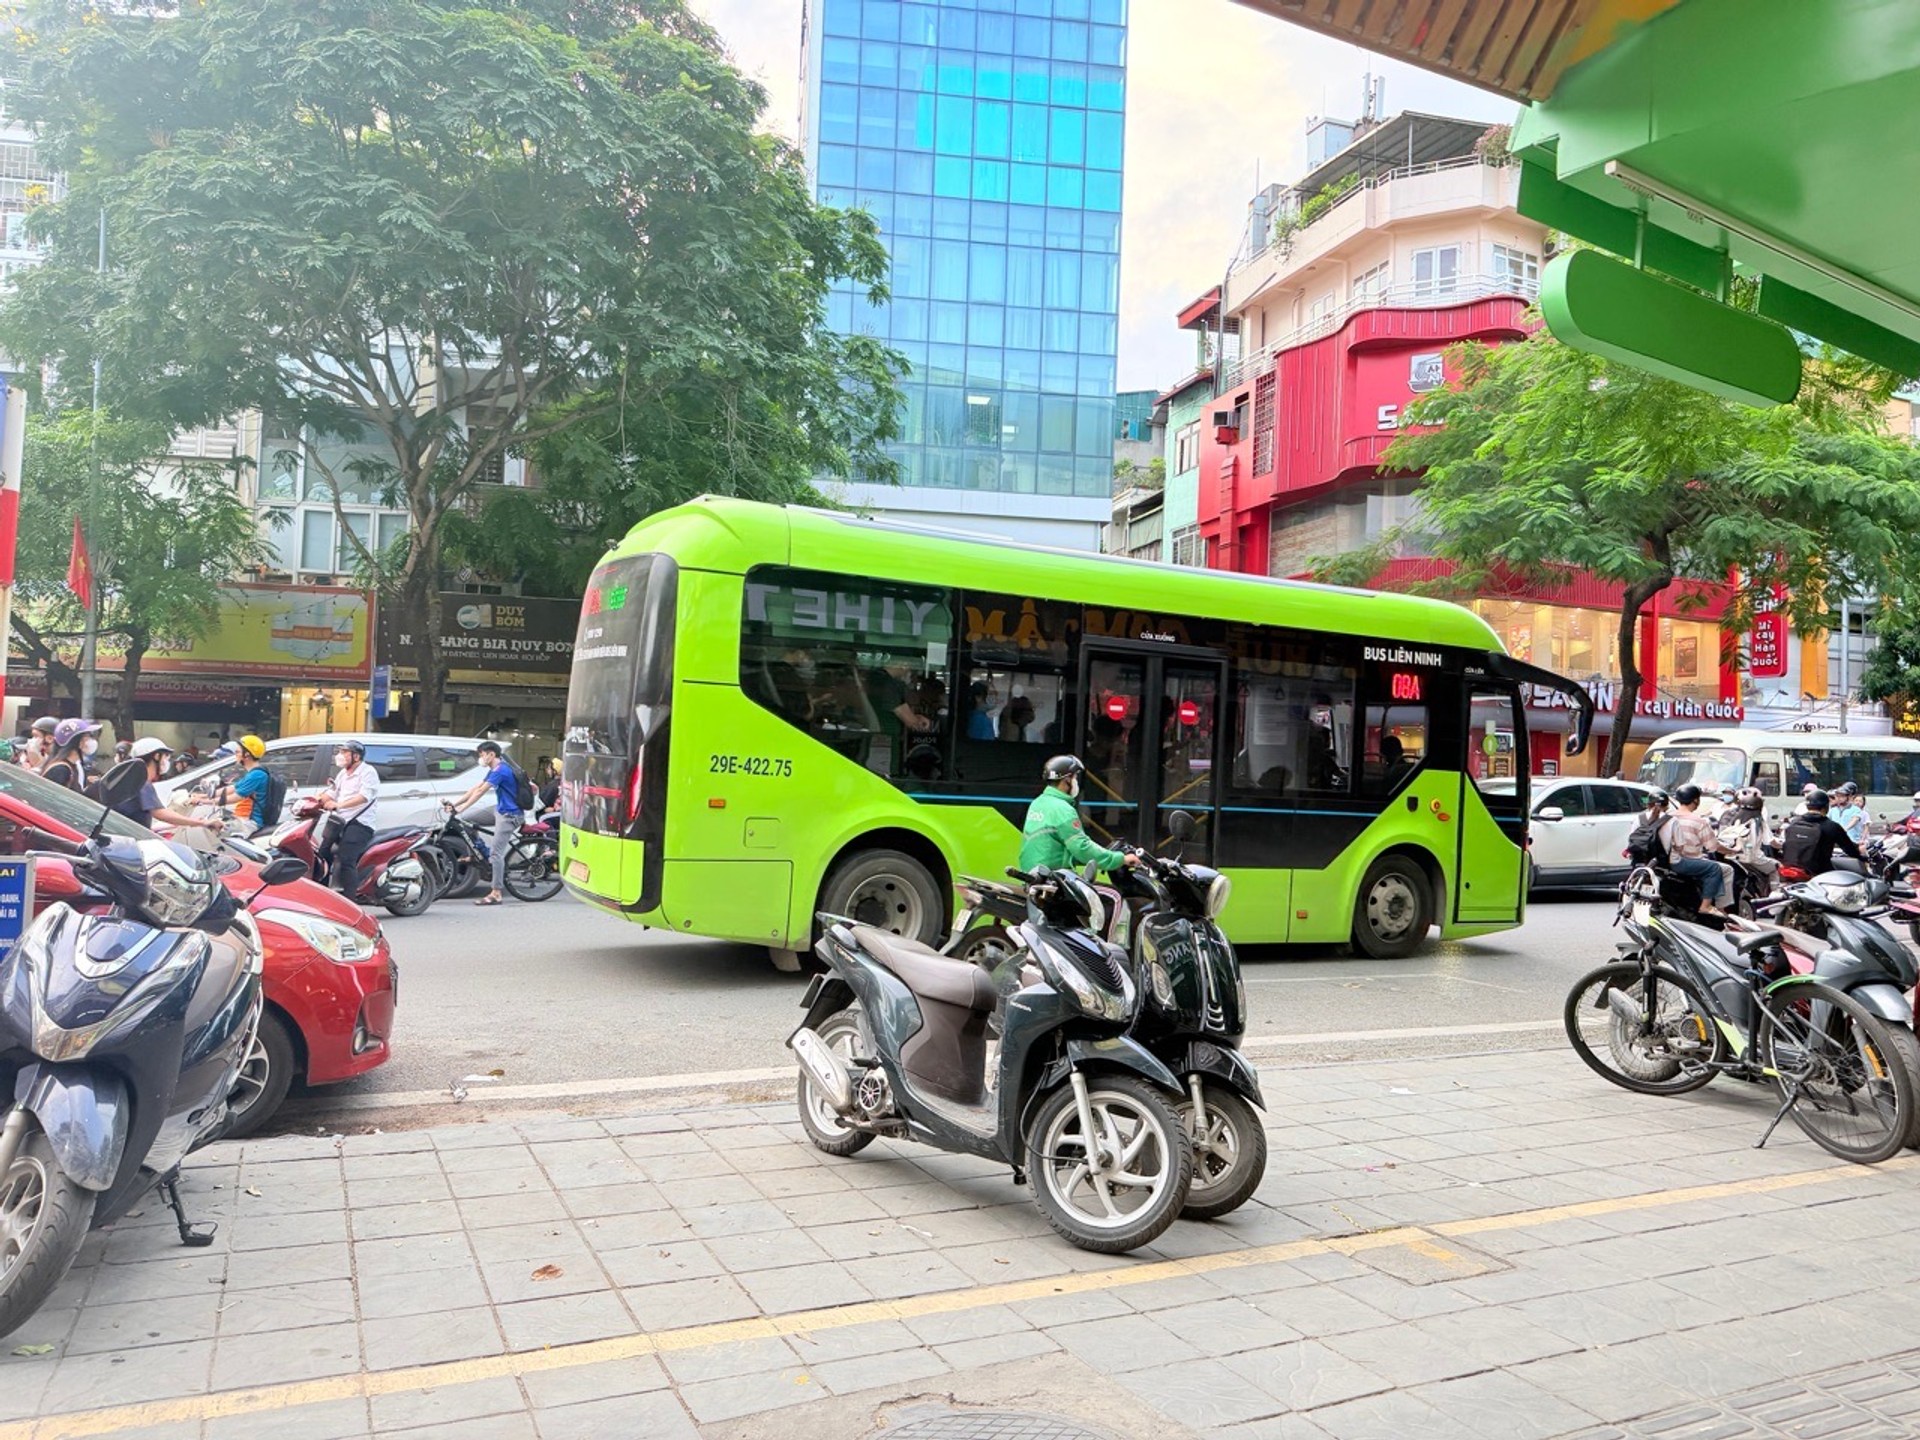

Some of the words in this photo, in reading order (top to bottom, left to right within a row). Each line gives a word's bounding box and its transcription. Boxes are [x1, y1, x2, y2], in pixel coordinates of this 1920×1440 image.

[496, 605, 526, 616] DUY
[1756, 630, 1775, 640] cay
[1754, 640, 1776, 653] Hàn
[1364, 646, 1387, 662] BUS
[1388, 647, 1413, 665] LIÊN
[1414, 651, 1442, 667] NINH
[1752, 652, 1779, 667] Quốc
[1645, 702, 1670, 719] cay
[1674, 697, 1702, 718] Hàn
[1705, 696, 1740, 719] Quốc
[709, 754, 793, 778] 29E-422.75
